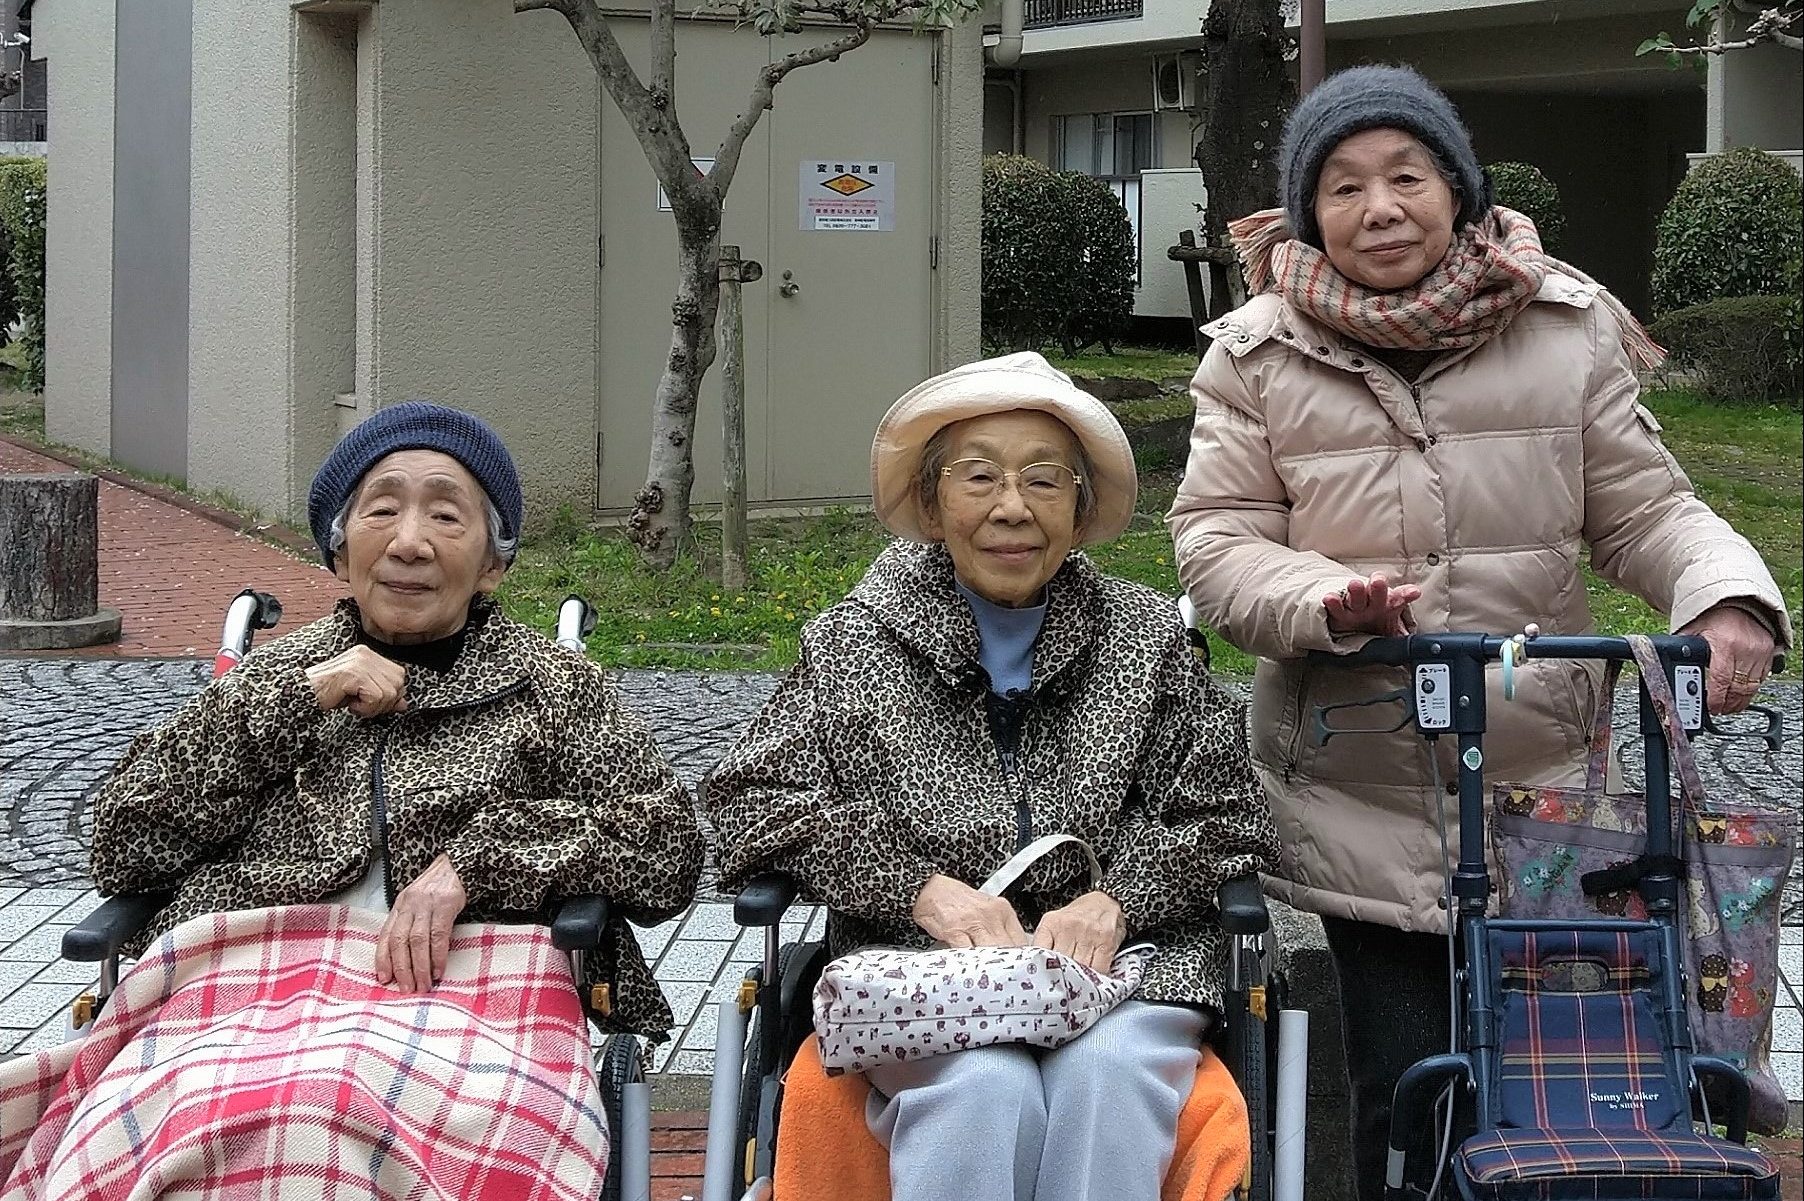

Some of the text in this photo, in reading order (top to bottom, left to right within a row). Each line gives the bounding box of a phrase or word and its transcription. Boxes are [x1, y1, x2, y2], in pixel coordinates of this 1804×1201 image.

[817, 164, 878, 174] 変電設備
[1590, 1091, 1659, 1103] Sunny Walker
